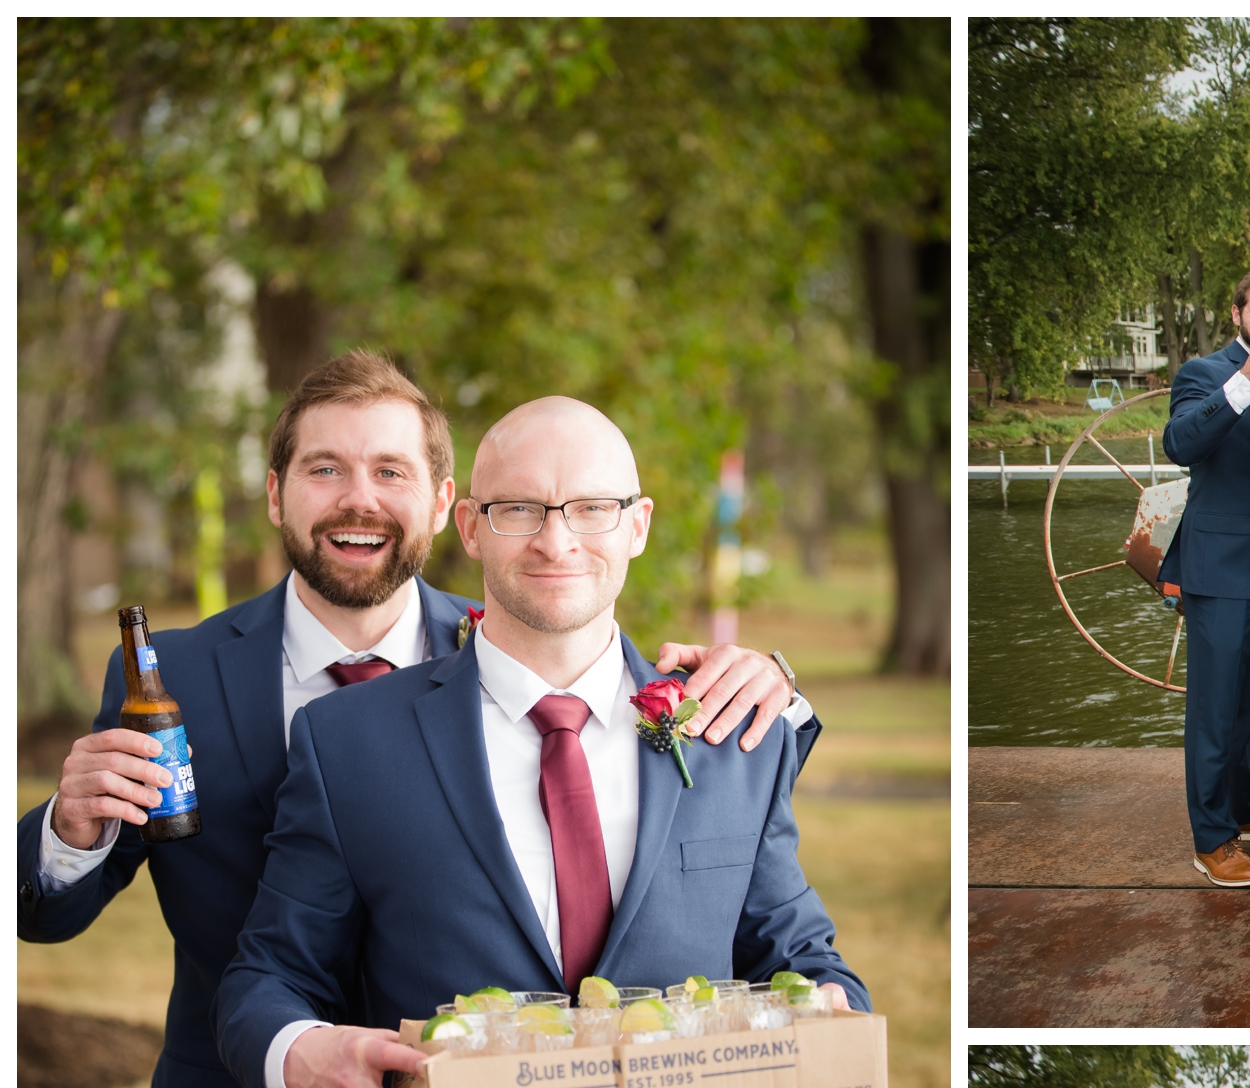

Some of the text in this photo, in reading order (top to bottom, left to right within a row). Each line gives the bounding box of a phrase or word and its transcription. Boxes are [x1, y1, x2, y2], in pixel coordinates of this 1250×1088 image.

[178, 763, 193, 780] BU
[174, 777, 195, 795] LIG
[516, 1061, 566, 1087] BLUE
[571, 1058, 622, 1078] MOON
[628, 1050, 707, 1073] BREWING
[660, 1071, 694, 1088] 1995
